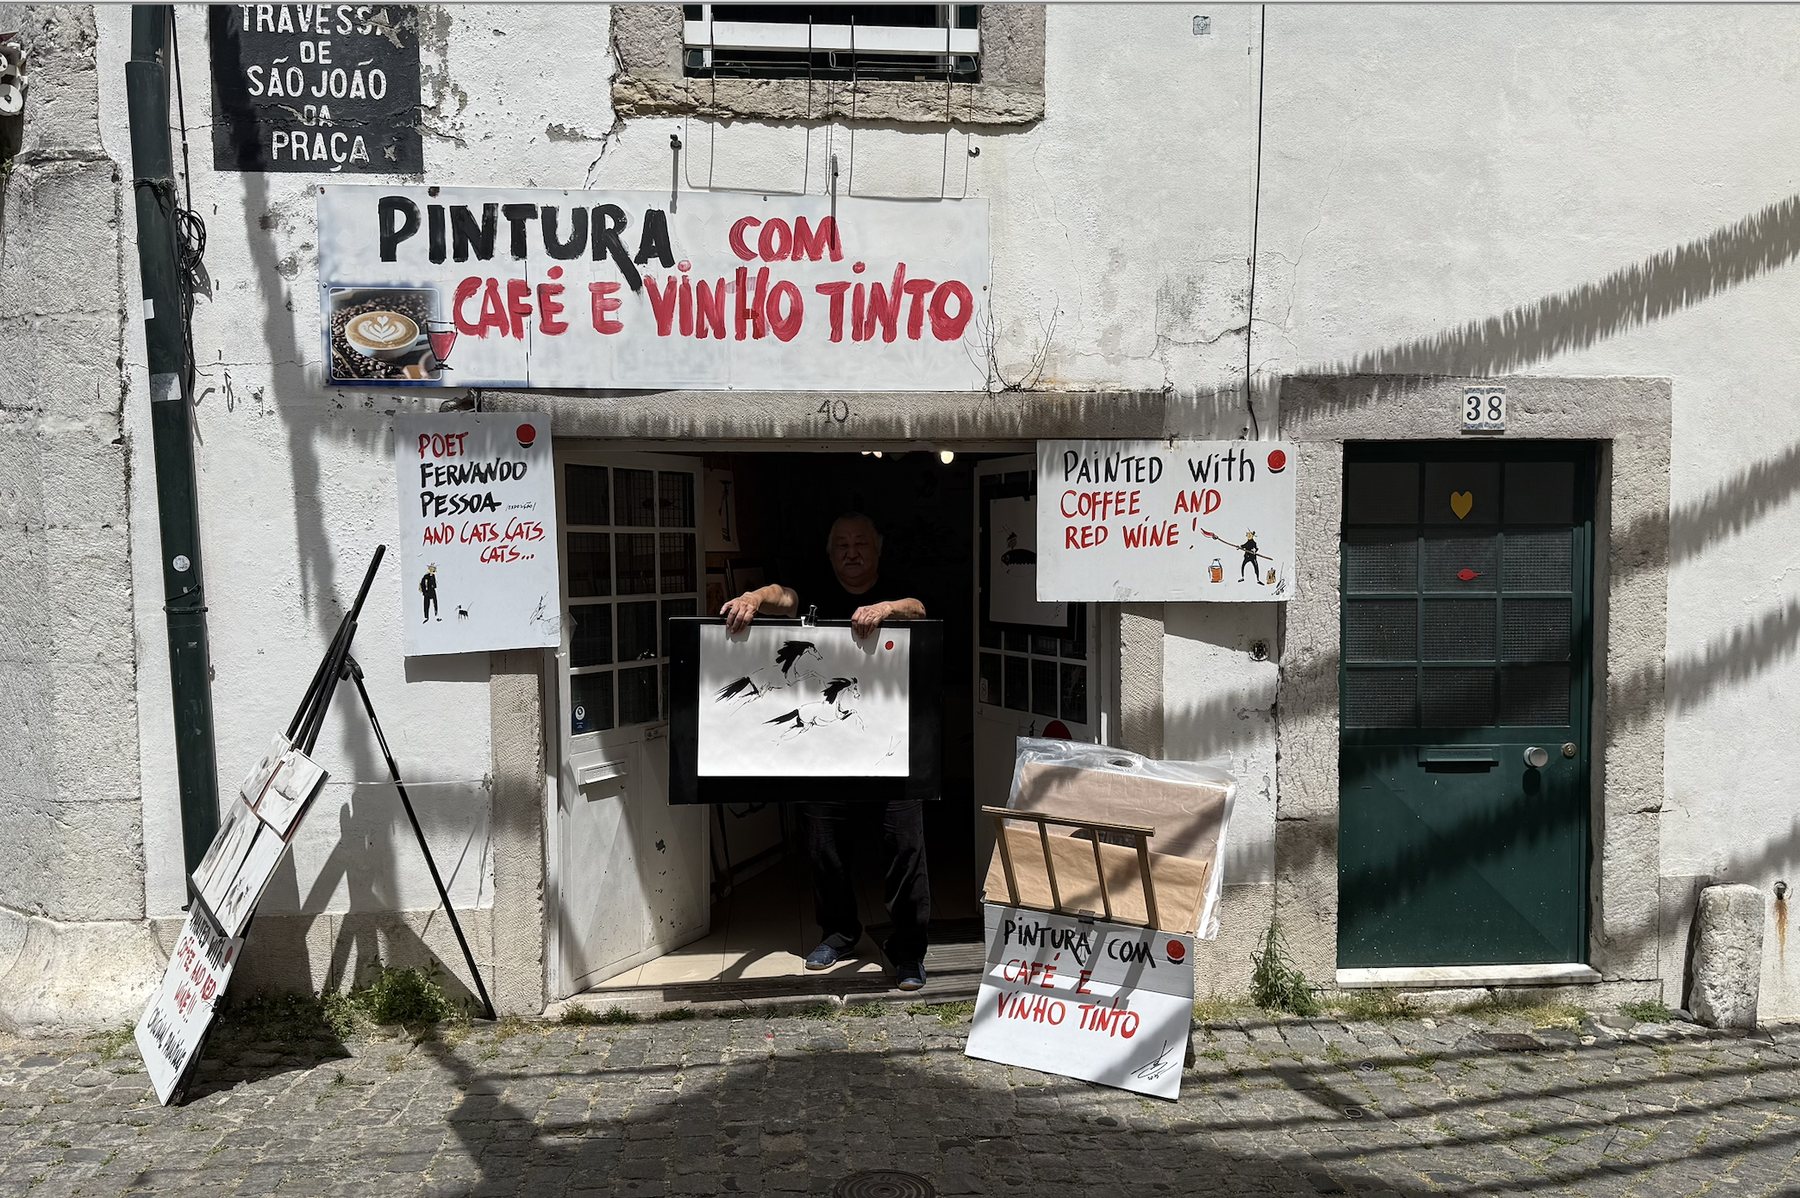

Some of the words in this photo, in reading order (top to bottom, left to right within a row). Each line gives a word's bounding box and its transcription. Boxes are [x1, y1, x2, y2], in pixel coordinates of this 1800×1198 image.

[238, 5, 390, 35] TRAVESS
[300, 41, 332, 64] DE
[247, 56, 304, 97] SÃO
[311, 58, 387, 100] JOÃO
[302, 104, 333, 127] DA
[271, 130, 370, 172] PRAÇA
[379, 196, 674, 291] PINTURA
[729, 216, 844, 262] COM
[588, 281, 624, 335] E
[1466, 395, 1503, 421] 38
[418, 432, 469, 459] POET
[420, 458, 527, 488] FERNANDO
[420, 491, 502, 518] PESSOA
[1060, 489, 1141, 521] COFFEE
[1174, 489, 1222, 515] AND
[423, 522, 455, 546] AND
[1065, 525, 1109, 549] RED
[480, 544, 535, 563] CATS...
[1107, 939, 1156, 968] COM
[1003, 953, 1060, 989] CAFÉ
[1076, 970, 1092, 994] E
